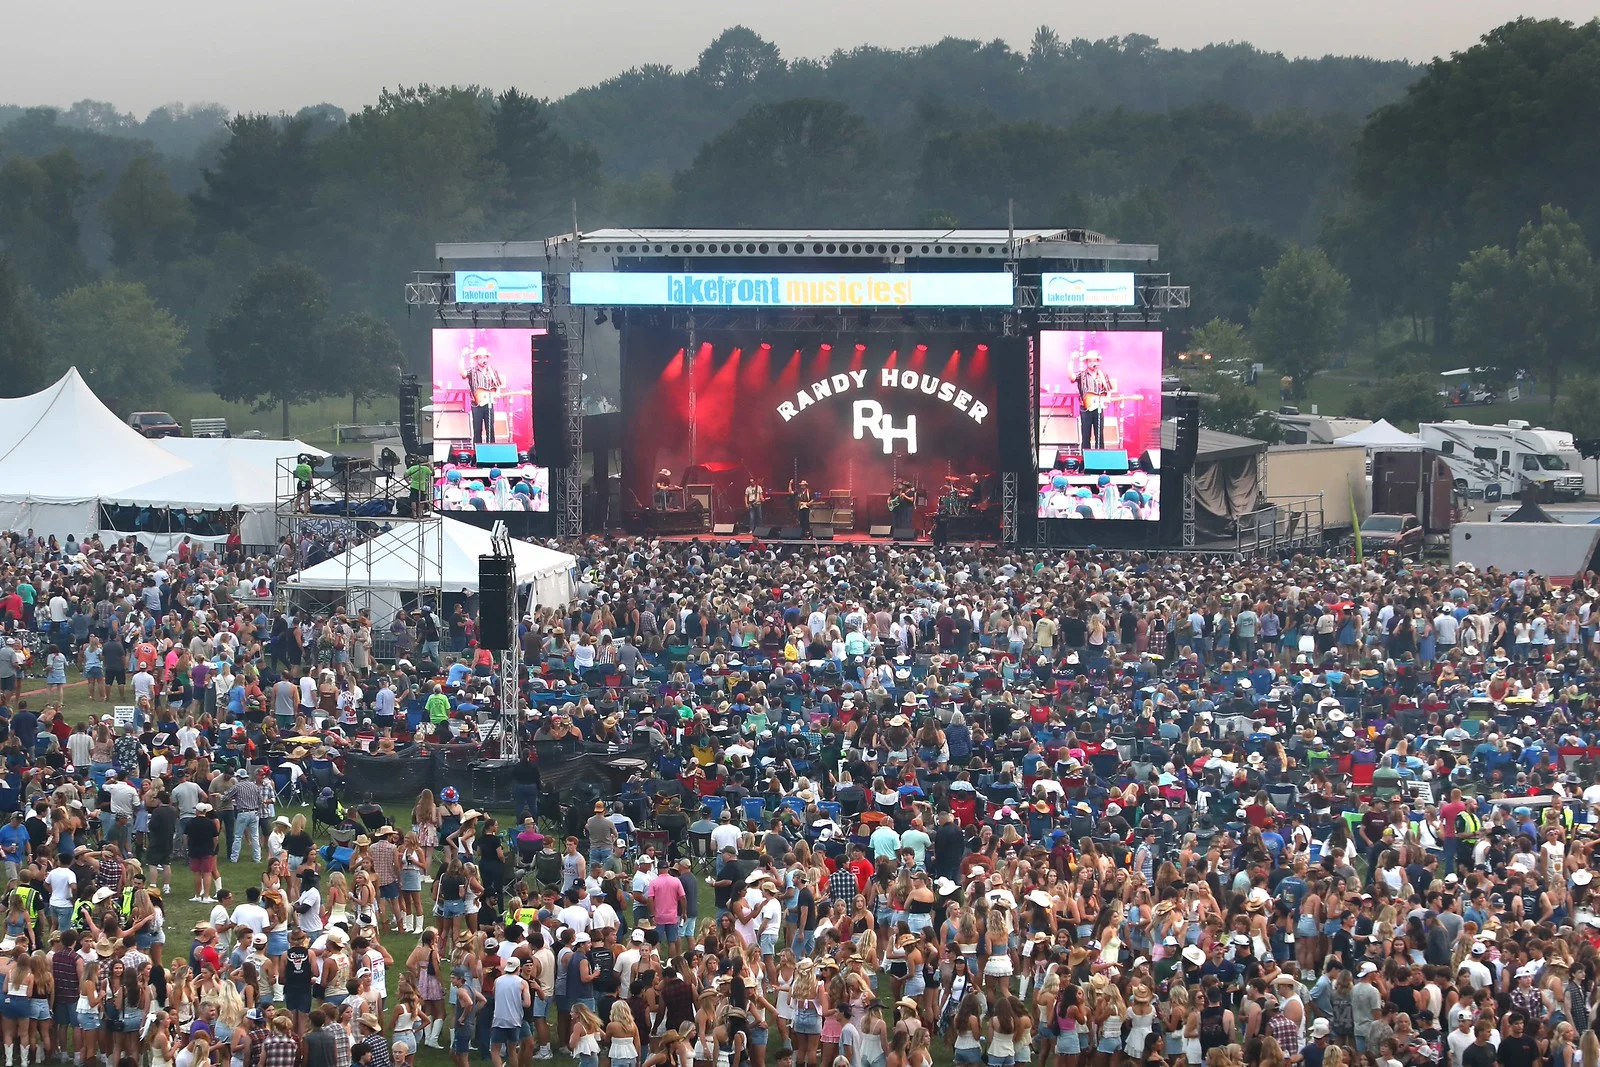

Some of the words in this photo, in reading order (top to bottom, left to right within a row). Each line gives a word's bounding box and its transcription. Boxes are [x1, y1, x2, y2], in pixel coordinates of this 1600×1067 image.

[462, 290, 498, 300] lakefront
[667, 275, 781, 304] lakefront
[1047, 292, 1085, 302] lakefront
[776, 368, 868, 422] RANDY
[881, 368, 989, 425] HOUSER
[852, 399, 918, 454] RH
